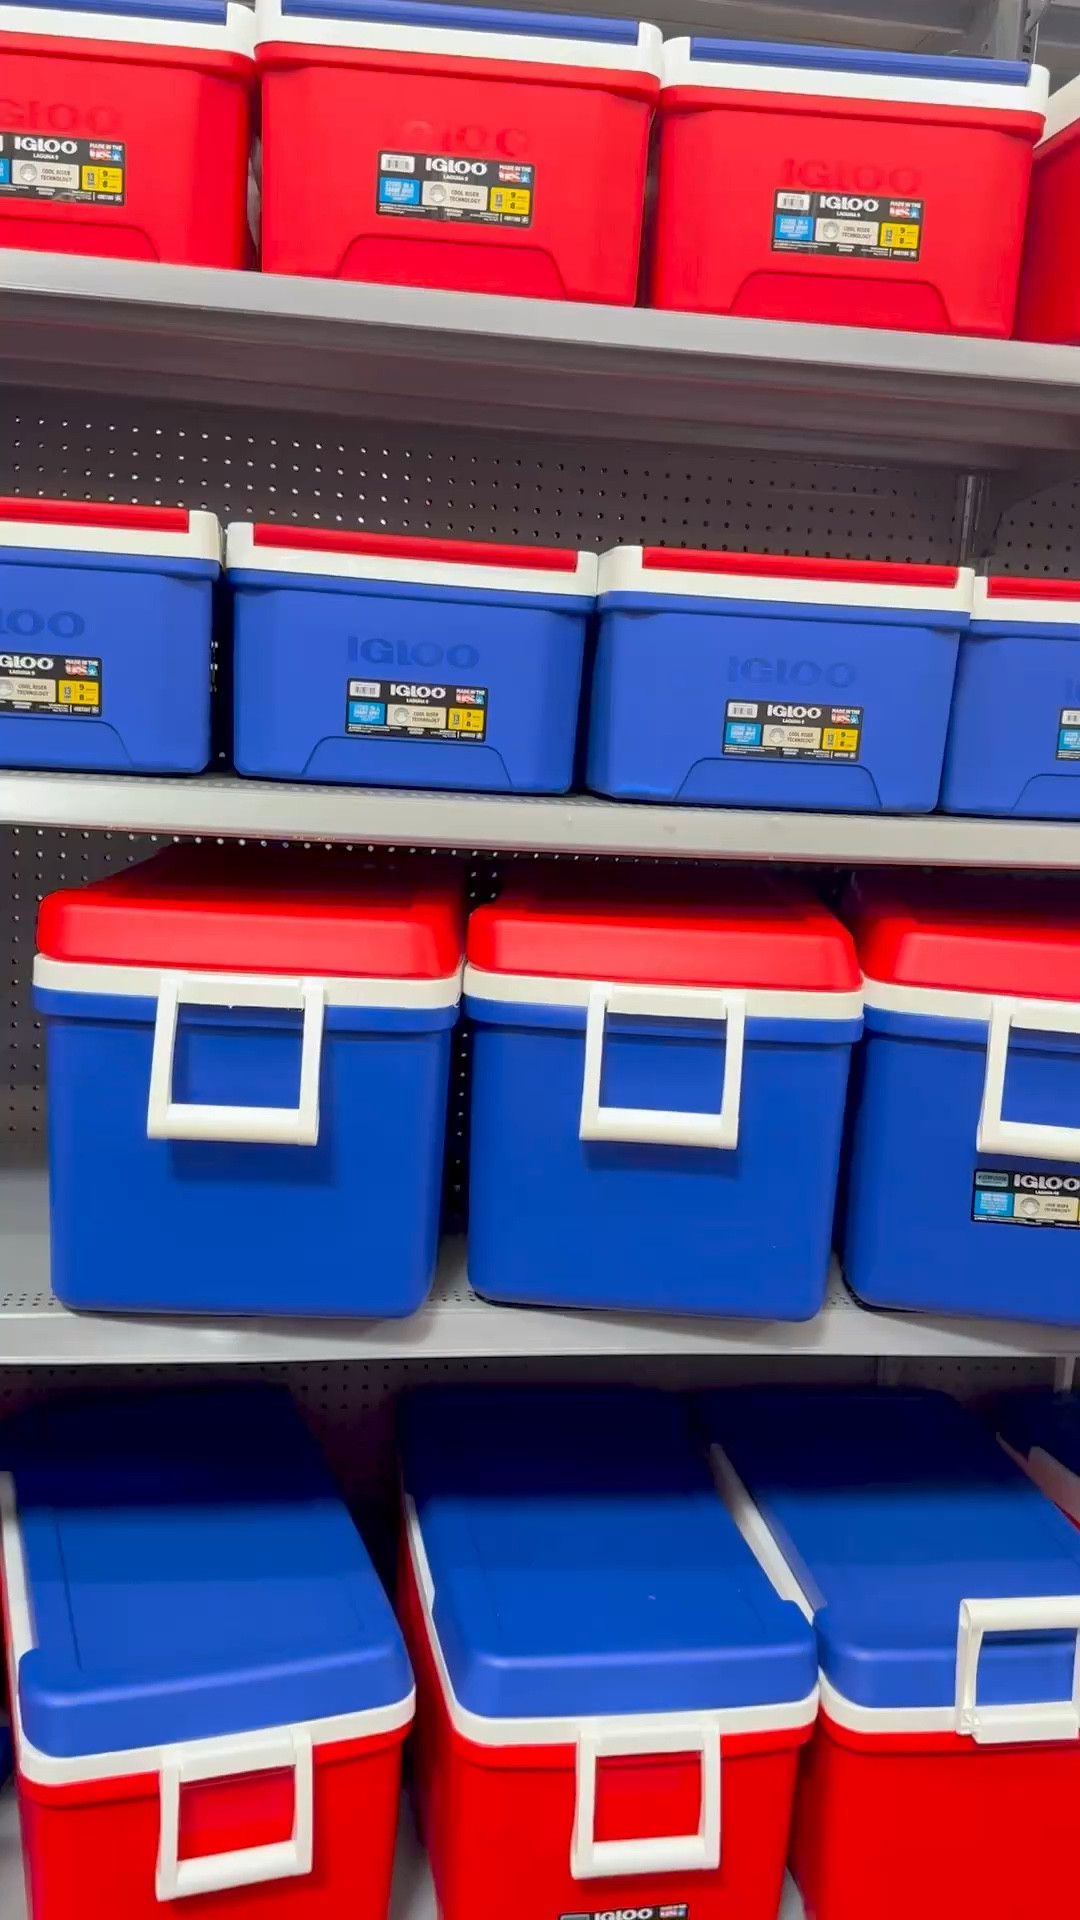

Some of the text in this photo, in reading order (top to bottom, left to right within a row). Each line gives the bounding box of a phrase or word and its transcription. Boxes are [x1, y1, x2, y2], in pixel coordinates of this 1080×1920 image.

[14, 136, 78, 155] IGLOO
[425, 157, 488, 176] IGLOO
[450, 196, 481, 204] TECHNOLOGY
[819, 195, 879, 212] IGLOO
[348, 635, 480, 670] IGLOO
[0, 654, 54, 670] GLOO
[728, 656, 858, 689] IGLOO
[390, 684, 446, 699] IGLOO
[767, 704, 821, 719] IGLOO
[1014, 1174, 1080, 1191] IGLOO
